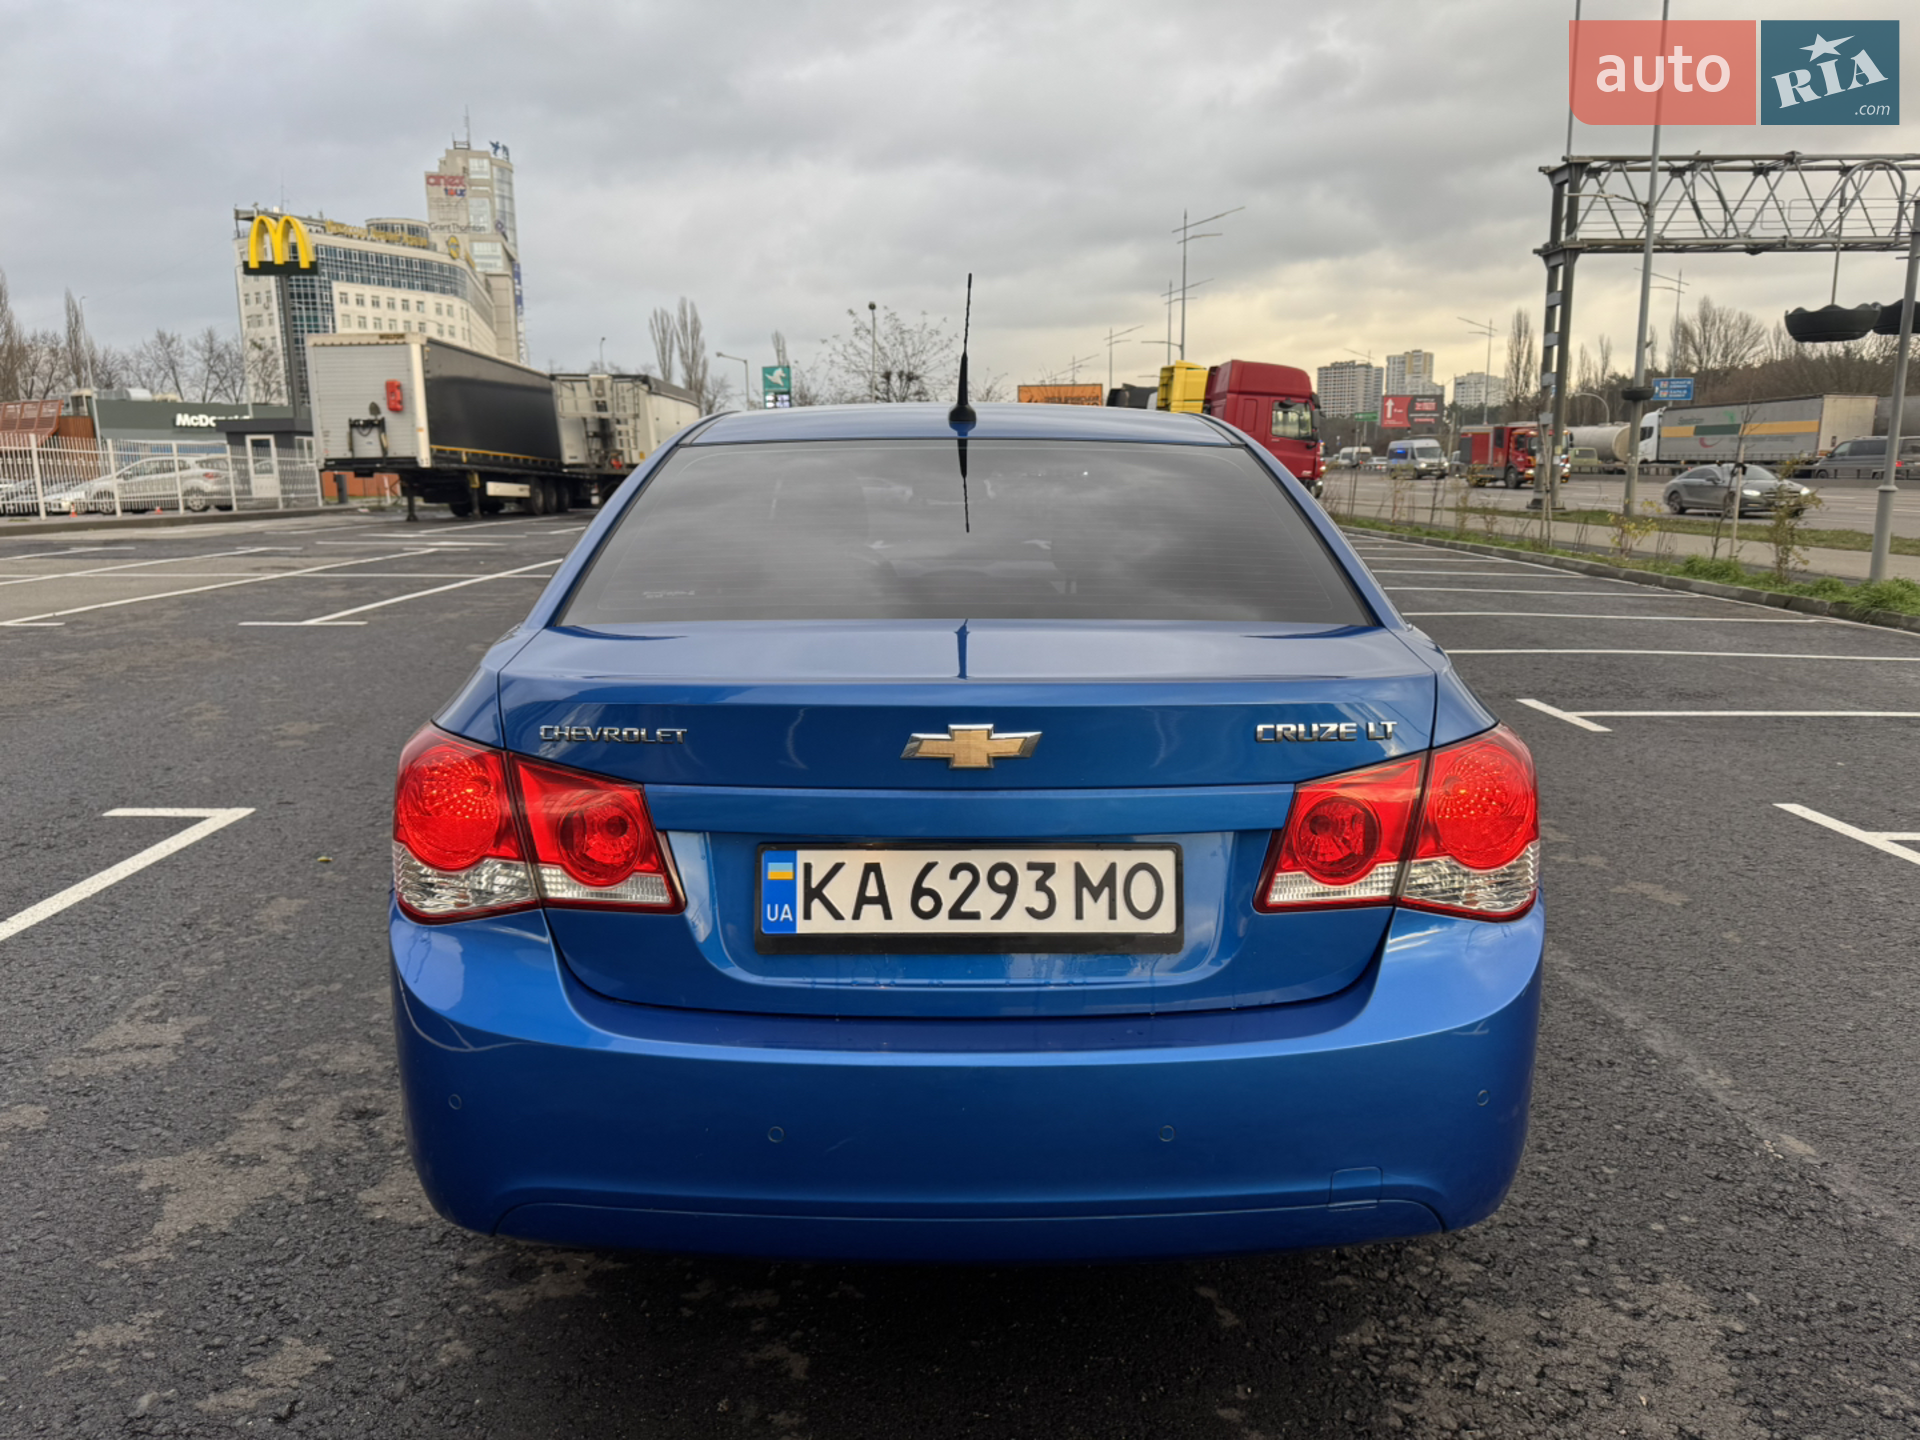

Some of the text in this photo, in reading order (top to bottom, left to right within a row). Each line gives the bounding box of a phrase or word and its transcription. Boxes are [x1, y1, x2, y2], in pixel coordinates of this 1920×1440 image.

[539, 725, 688, 744] CHEVROLET
[1256, 721, 1398, 742] CRUZE LT
[802, 861, 1164, 921] KA 6293 MO
[767, 904, 793, 922] UA
